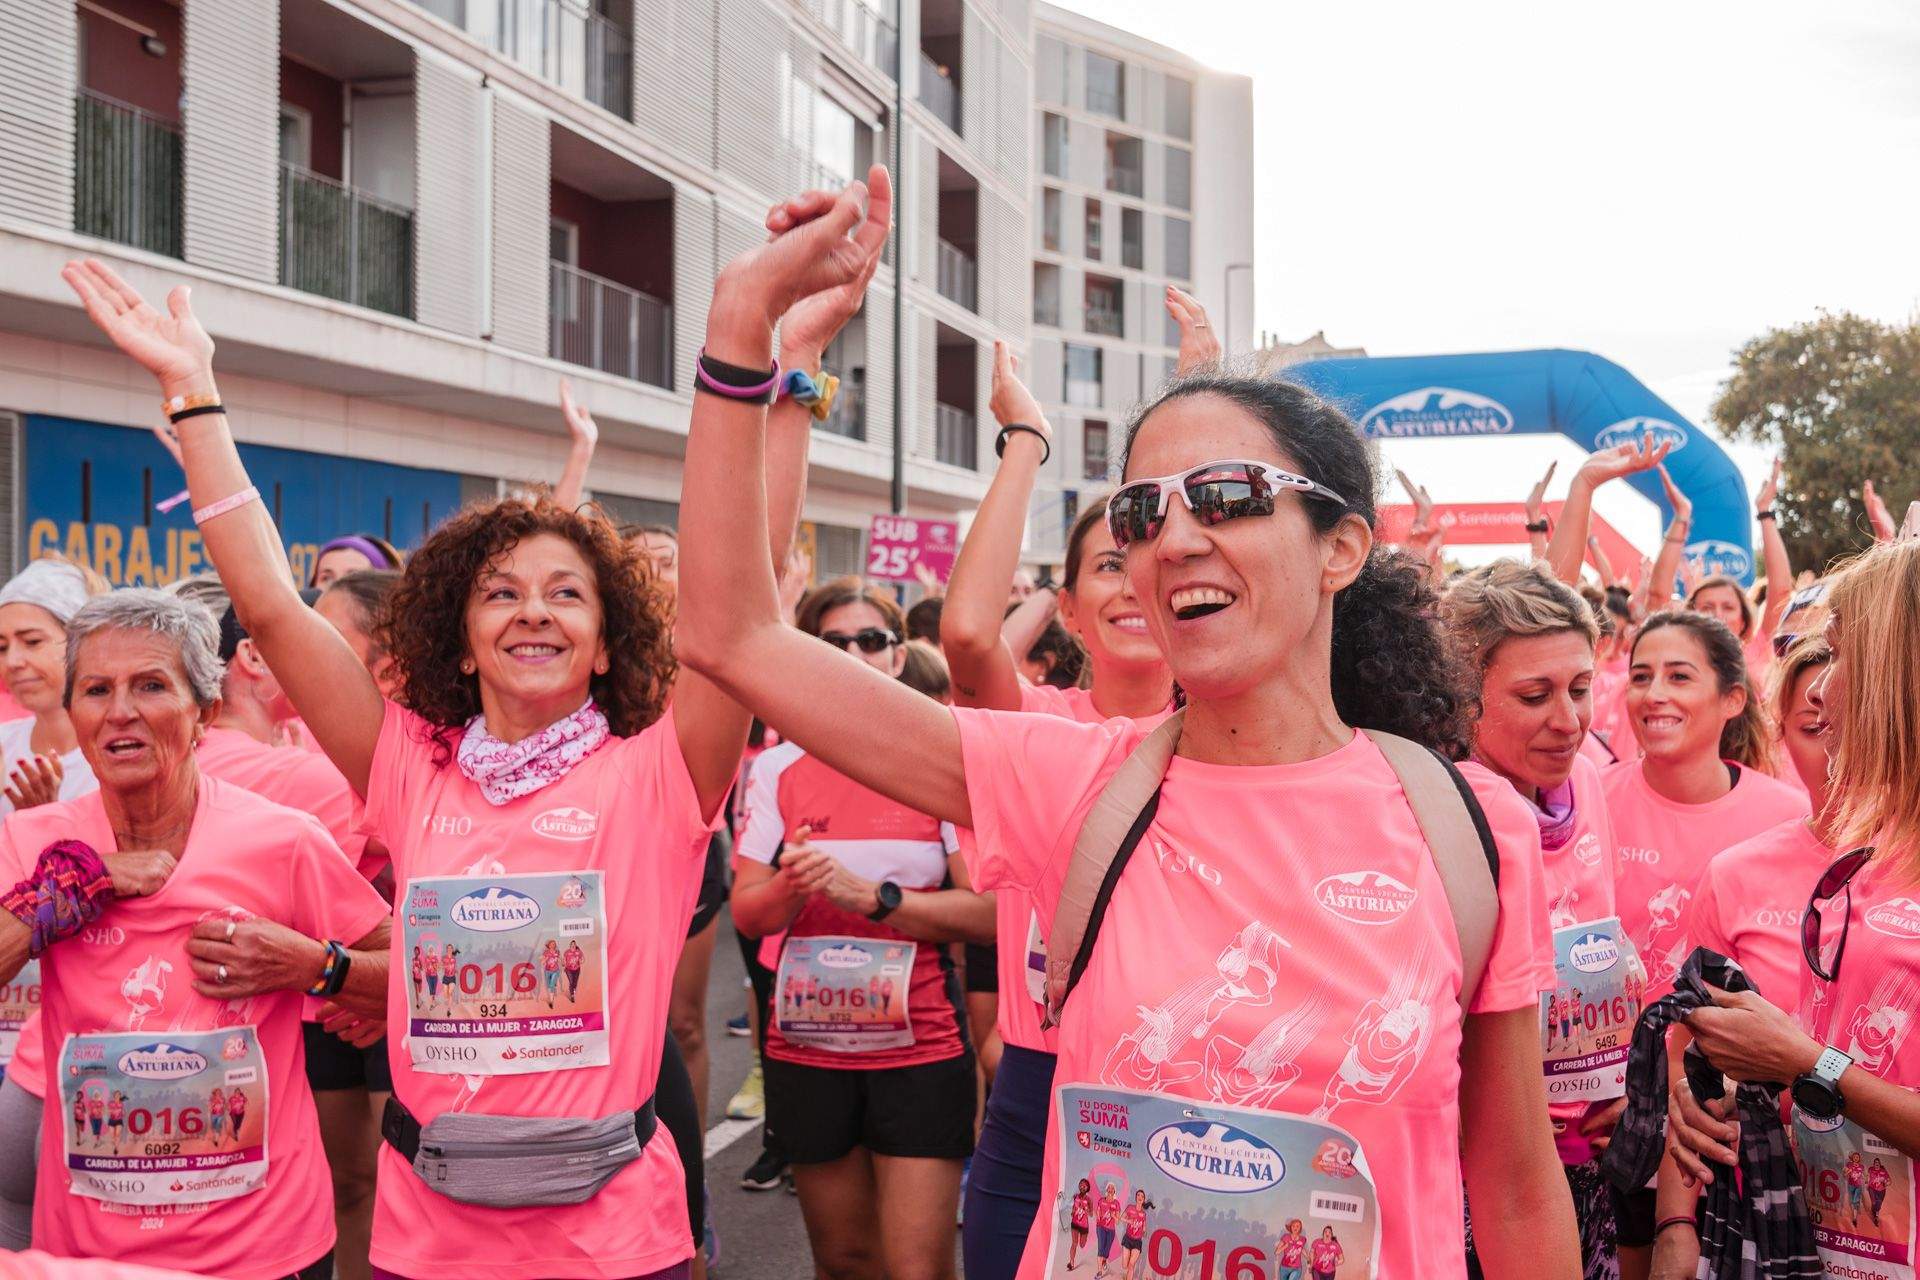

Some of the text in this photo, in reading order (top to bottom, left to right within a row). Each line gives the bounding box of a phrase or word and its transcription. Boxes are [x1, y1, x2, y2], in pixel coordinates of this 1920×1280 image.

[1375, 416, 1501, 436] ASTURIANA
[874, 518, 919, 543] SUB
[412, 898, 439, 909] SUMA
[457, 904, 534, 922] ASTURIANA
[83, 927, 126, 946] SHO
[459, 962, 537, 994] 016
[818, 987, 866, 1007] 016
[480, 1003, 508, 1018] 934
[1584, 996, 1626, 1031] 016
[424, 1017, 584, 1034] CARRERA DE LA MUJER ZARAGOZA
[1595, 1034, 1618, 1050] 6492
[426, 1043, 585, 1061] OYSHO Santander
[124, 1056, 201, 1073] ASTURIANA
[1553, 1060, 1587, 1072] CARRERA
[1587, 1057, 1596, 1067] DE
[1595, 1053, 1605, 1064] LA
[1549, 1077, 1601, 1093] OYSHO
[1078, 1099, 1131, 1116] TU DORSAL
[128, 1106, 204, 1135] 016
[1079, 1108, 1130, 1131] SUMA
[145, 1143, 181, 1156] 6092
[1093, 1132, 1132, 1149] Zaragoza
[1175, 1137, 1272, 1161] CENTRAL LECHERA
[85, 1153, 245, 1170] CARRERA DE LA MUJER ZARAGOZA
[1093, 1144, 1132, 1160] DEPORTE
[1156, 1136, 1274, 1182] ASTURIANA
[1322, 1141, 1352, 1165] 20
[88, 1174, 246, 1194] OYSHO Santander
[161, 1204, 174, 1216] LA
[1148, 1229, 1267, 1280] 016
[1835, 1235, 1886, 1256] ZARAGOZA
[1826, 1261, 1889, 1280] Santander
